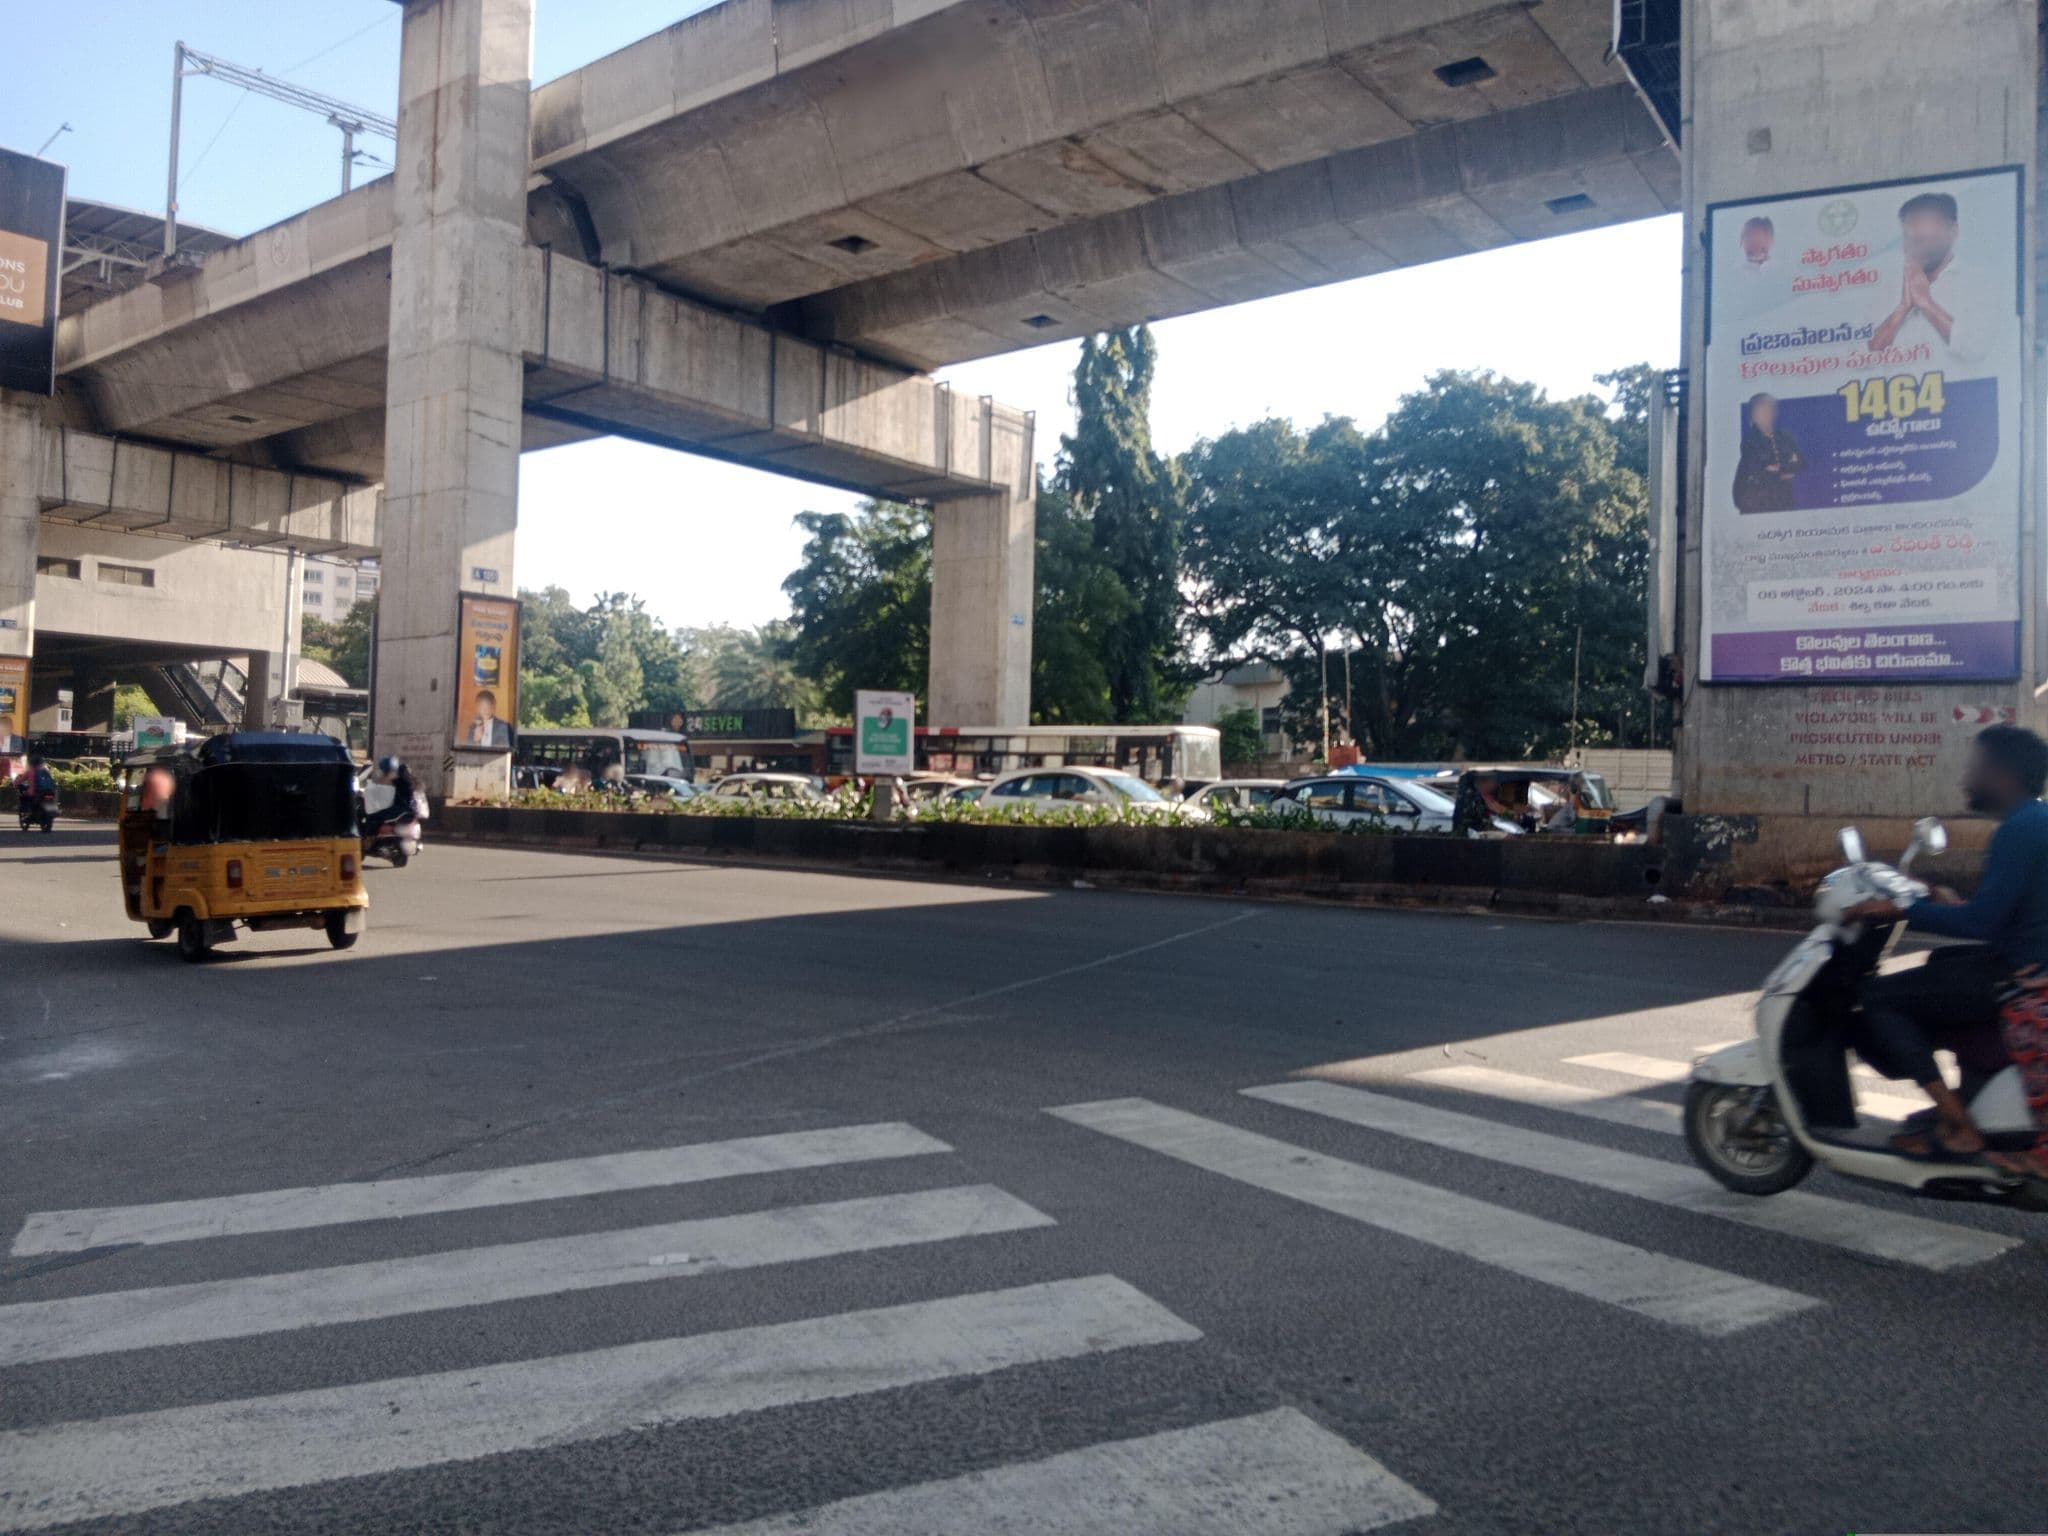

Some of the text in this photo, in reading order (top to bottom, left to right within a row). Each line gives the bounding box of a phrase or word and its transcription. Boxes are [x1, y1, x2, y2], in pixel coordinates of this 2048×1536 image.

[1801, 243, 1867, 267] స్వాగతం
[1791, 269, 1878, 292] సుస్వాగతం
[1838, 370, 1945, 423] 1464
[1889, 733, 1942, 745] UNDER
[1795, 754, 1847, 766] METRO
[1860, 754, 1902, 766] STATE
[1905, 754, 1937, 768] ACT
